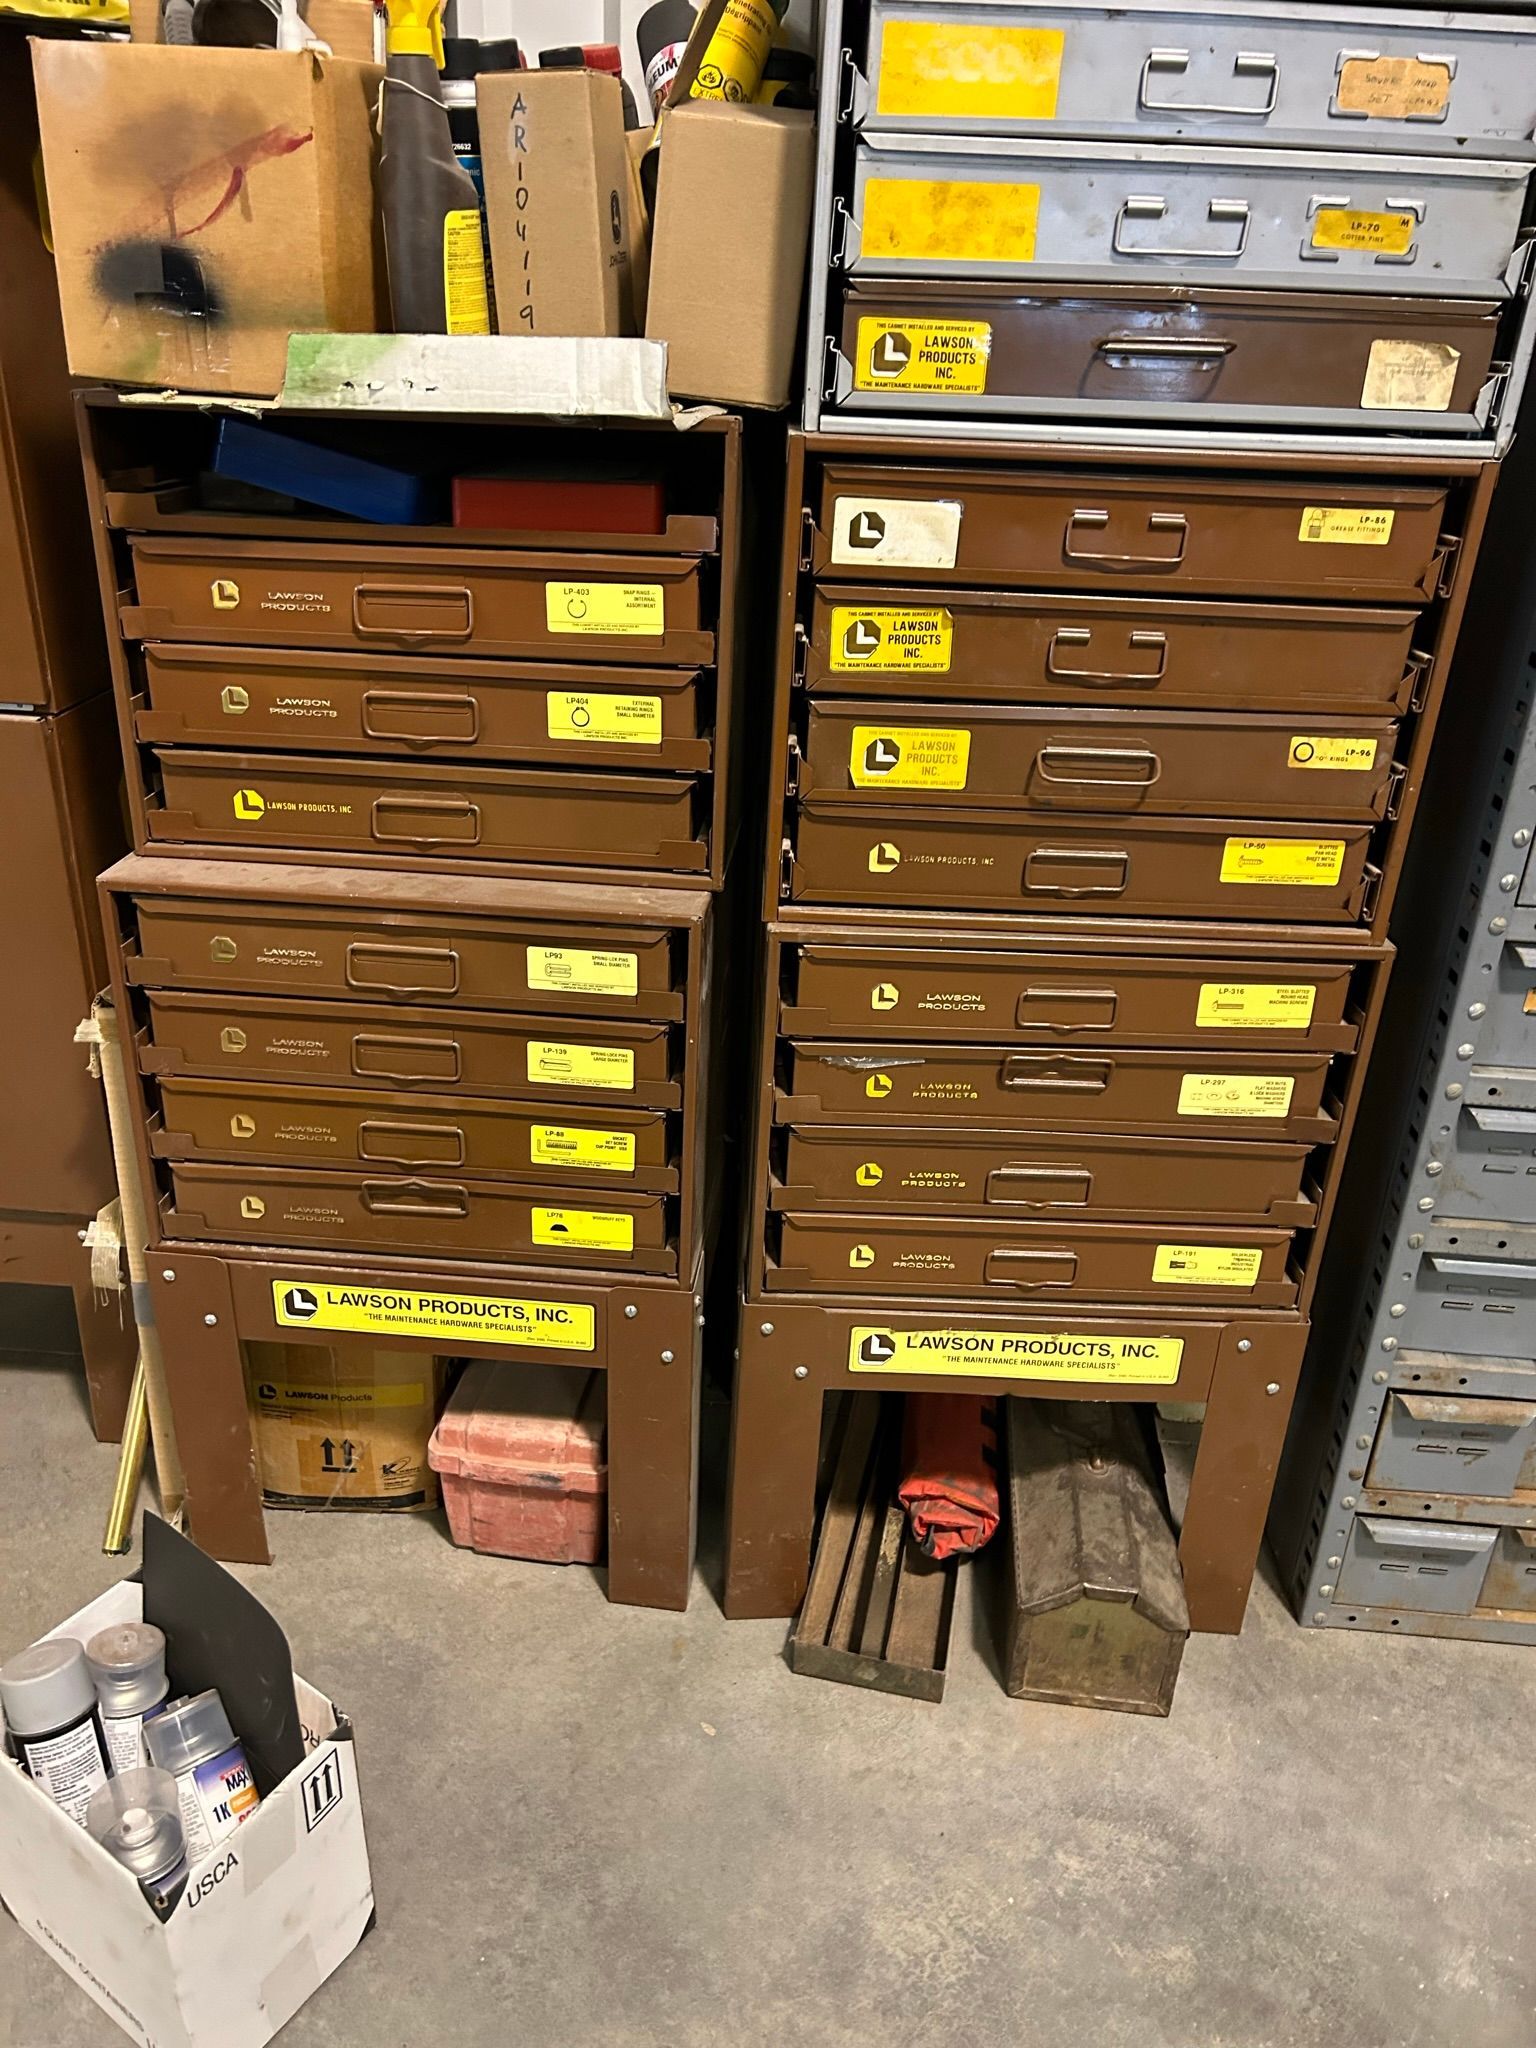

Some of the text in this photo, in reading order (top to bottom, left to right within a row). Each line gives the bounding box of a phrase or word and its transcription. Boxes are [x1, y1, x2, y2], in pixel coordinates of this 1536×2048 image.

[1351, 221, 1380, 232] LP-70
[925, 335, 974, 349] LAWSON
[918, 350, 976, 365] PRODUCTS
[935, 367, 956, 379] INC.
[1360, 516, 1387, 524] LP-86
[268, 592, 324, 601] LAWSON
[563, 587, 590, 596] LP-403
[260, 602, 331, 612] PRODUCTS
[893, 621, 938, 632] LAWSON
[888, 634, 942, 645] PRODUCTS
[903, 647, 923, 659] INC.
[276, 698, 331, 707] LAWSON
[566, 697, 589, 705] LP404
[269, 707, 338, 717] PRODUCTS
[911, 741, 956, 752] LAWSON
[1345, 748, 1371, 757] LP-96
[906, 753, 959, 765] PRODUCTS
[921, 766, 941, 777] INC.
[267, 801, 297, 811] LAWSON
[904, 855, 935, 863] LAWSON
[263, 947, 317, 957] LAWSON
[926, 993, 981, 1002] LAWSON
[918, 1002, 986, 1011] PRODUCTS
[272, 1038, 324, 1047] LAWSON
[266, 1046, 330, 1057] PRODUCTS
[543, 1047, 567, 1055] LP-139
[912, 1091, 978, 1099] PRODUCTS
[281, 1125, 331, 1134] LAWSON
[274, 1133, 337, 1142] PRODUCTS
[901, 1180, 966, 1188] PRODUCTS
[289, 1206, 338, 1215] LAWSON
[283, 1214, 345, 1223] PRODUCTS
[901, 1253, 951, 1261] LAWSON
[893, 1261, 955, 1270] PRODUCTS
[327, 1291, 574, 1324] LAWSON PRODUCTS, INC.
[384, 1314, 438, 1326] MAINTENANCE
[440, 1319, 483, 1329] HARDWARE
[485, 1322, 537, 1333] SPECIALISTS"
[906, 1335, 1159, 1359] LAWSON PRODUCTS, INC.
[963, 1356, 1018, 1366] MAINTENANCE
[1021, 1359, 1064, 1368] HARDWARE
[1066, 1361, 1120, 1370] SPECIALISTS"
[284, 1390, 330, 1401] LAWSON
[225, 1769, 249, 1792] MAX
[213, 1801, 231, 1823] 1K
[187, 1852, 239, 1908] USCA
